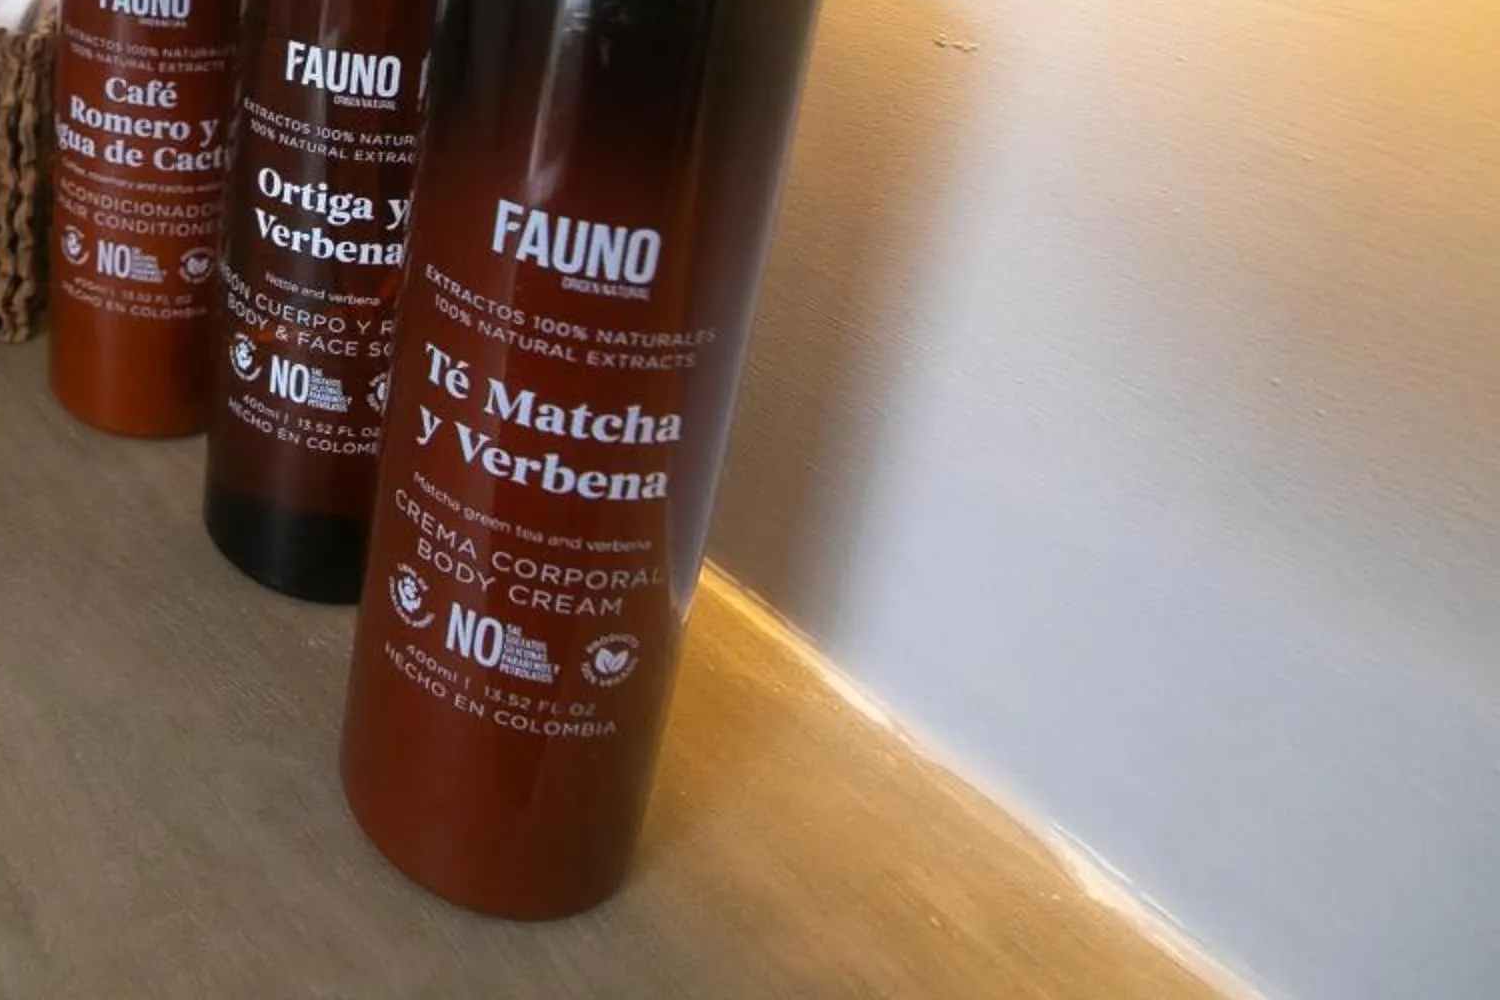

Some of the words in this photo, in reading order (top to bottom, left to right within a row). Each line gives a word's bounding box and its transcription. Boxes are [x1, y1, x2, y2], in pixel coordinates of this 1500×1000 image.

[105, 76, 179, 108] Café
[285, 39, 401, 97] FAUNO
[69, 95, 191, 141] Romero
[200, 119, 219, 148] y
[244, 97, 310, 134] EXTRACTOS
[316, 126, 355, 142] 100%
[279, 133, 348, 159] NATURAL
[104, 140, 144, 167] de
[258, 167, 374, 226] Ortiga
[386, 198, 411, 230] y
[97, 238, 131, 280] NO
[255, 207, 405, 265] Verbena
[492, 199, 662, 284] FAUNO
[228, 292, 268, 330] BODY
[275, 325, 289, 342] &
[297, 331, 359, 357] FACE
[255, 293, 346, 333] CUERPO
[357, 320, 372, 335] Y
[425, 264, 525, 326] EXTRACTOS
[532, 315, 588, 341] 100%
[595, 328, 717, 348] NATURALES
[435, 294, 473, 327] 100%
[477, 319, 577, 363] NATURAL
[586, 353, 698, 370] EXTRACTS
[269, 354, 309, 404] NO
[426, 344, 470, 399] Té
[483, 378, 682, 444] Matcha
[276, 427, 300, 445] EN
[416, 405, 443, 445] y
[454, 421, 668, 500] Verbena
[395, 489, 478, 560] CREMA
[491, 551, 665, 590] CORPORAL
[412, 472, 461, 512] Matcha
[463, 507, 511, 534] green
[515, 525, 544, 544] tea
[548, 532, 582, 550] and
[585, 537, 652, 552] verbena
[416, 537, 496, 593] BODY
[508, 585, 623, 617] CREAM
[445, 601, 503, 668] NO
[384, 640, 447, 697] HECHO
[453, 694, 486, 716] EN
[494, 711, 618, 738] COLOMBIA
[406, 645, 457, 684] 400ml
[485, 685, 531, 711] 13.52
[538, 700, 563, 715] FL
[569, 703, 597, 718] OZ
